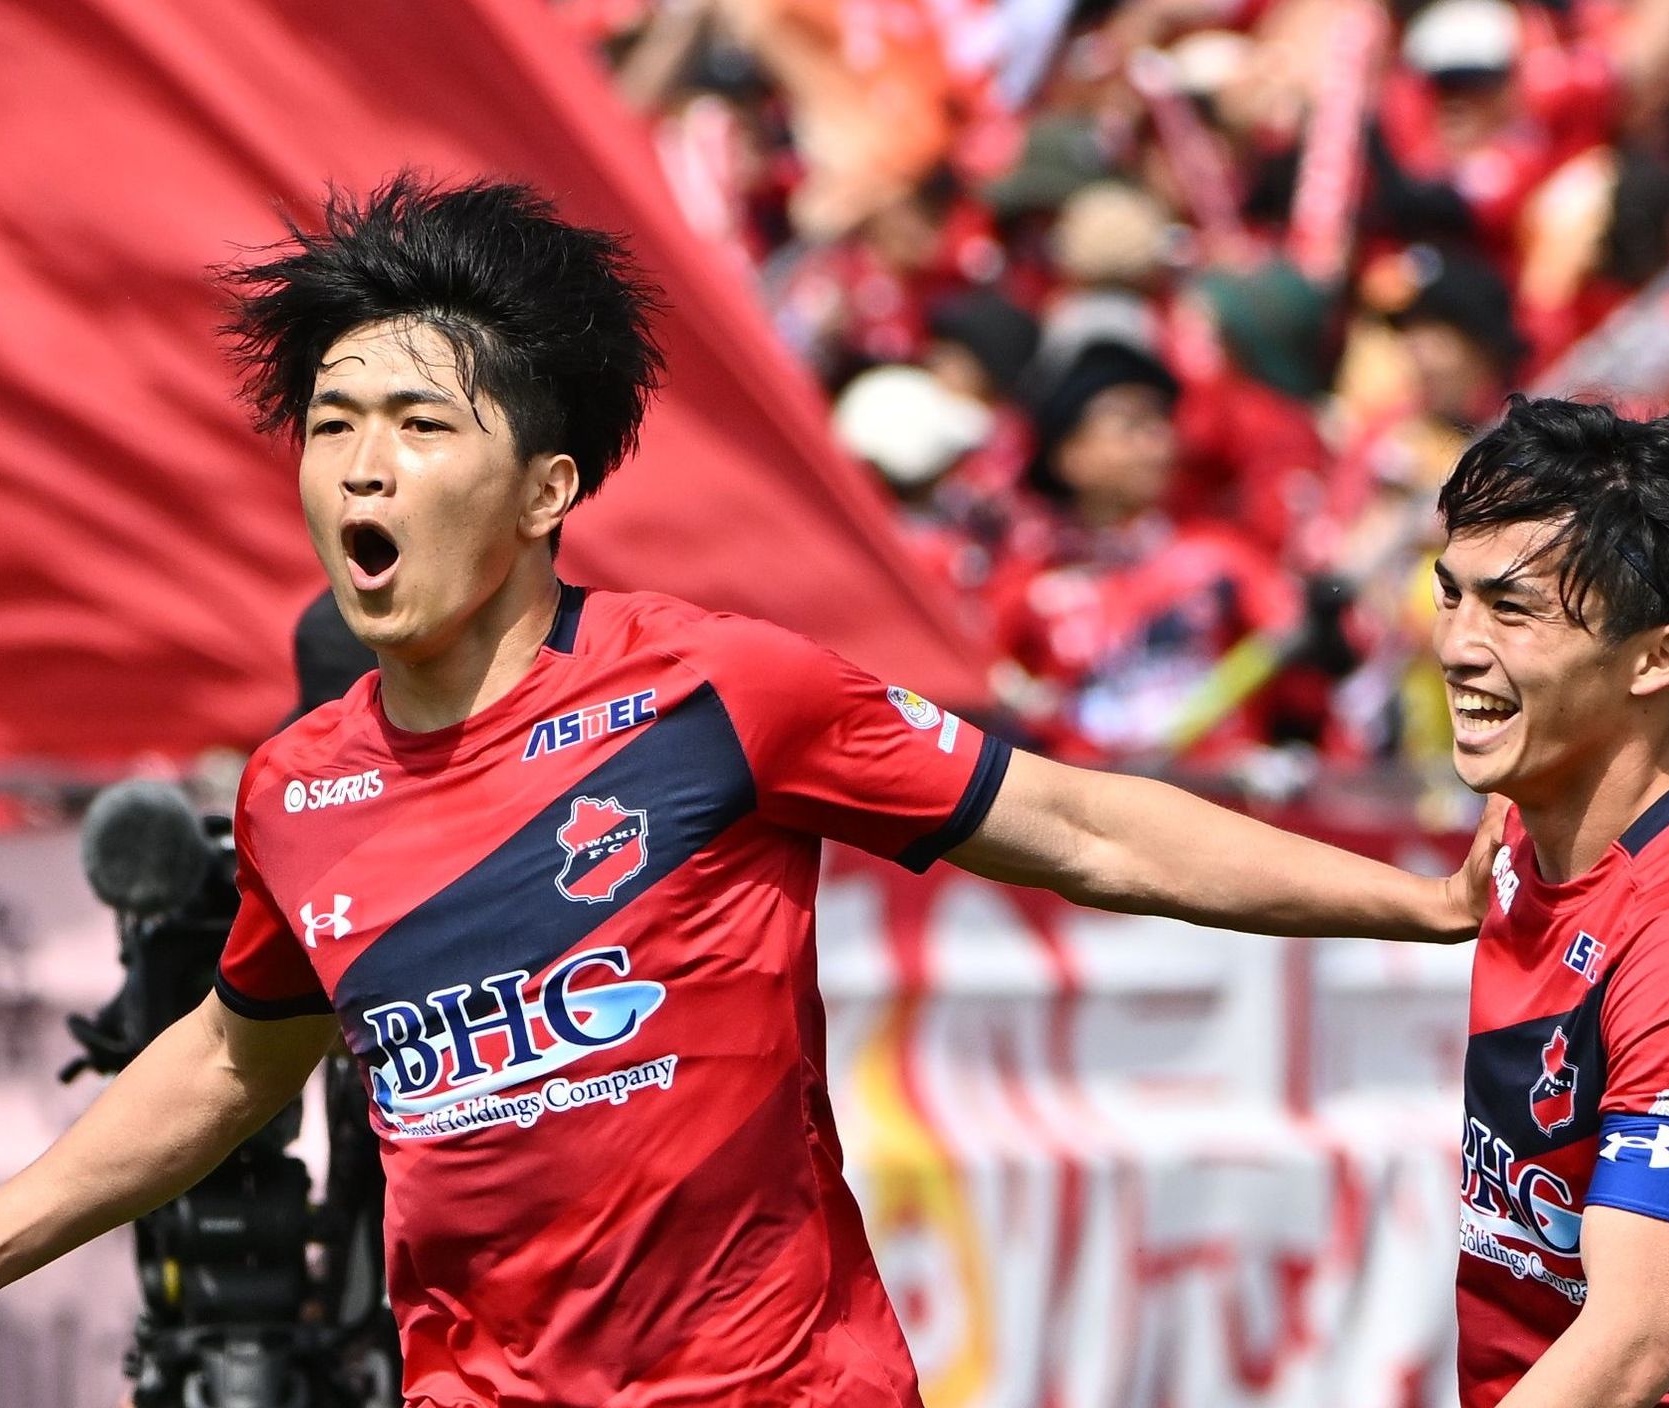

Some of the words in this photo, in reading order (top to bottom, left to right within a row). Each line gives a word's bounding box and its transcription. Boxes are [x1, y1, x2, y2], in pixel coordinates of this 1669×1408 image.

[521, 688, 658, 762] ASTEC
[307, 769, 385, 810] STARTS
[576, 827, 638, 852] IWAKI
[364, 947, 640, 1095] BHC
[435, 1095, 541, 1134] Holdings
[544, 1056, 676, 1109] Company
[1528, 1254, 1588, 1300] Compa
